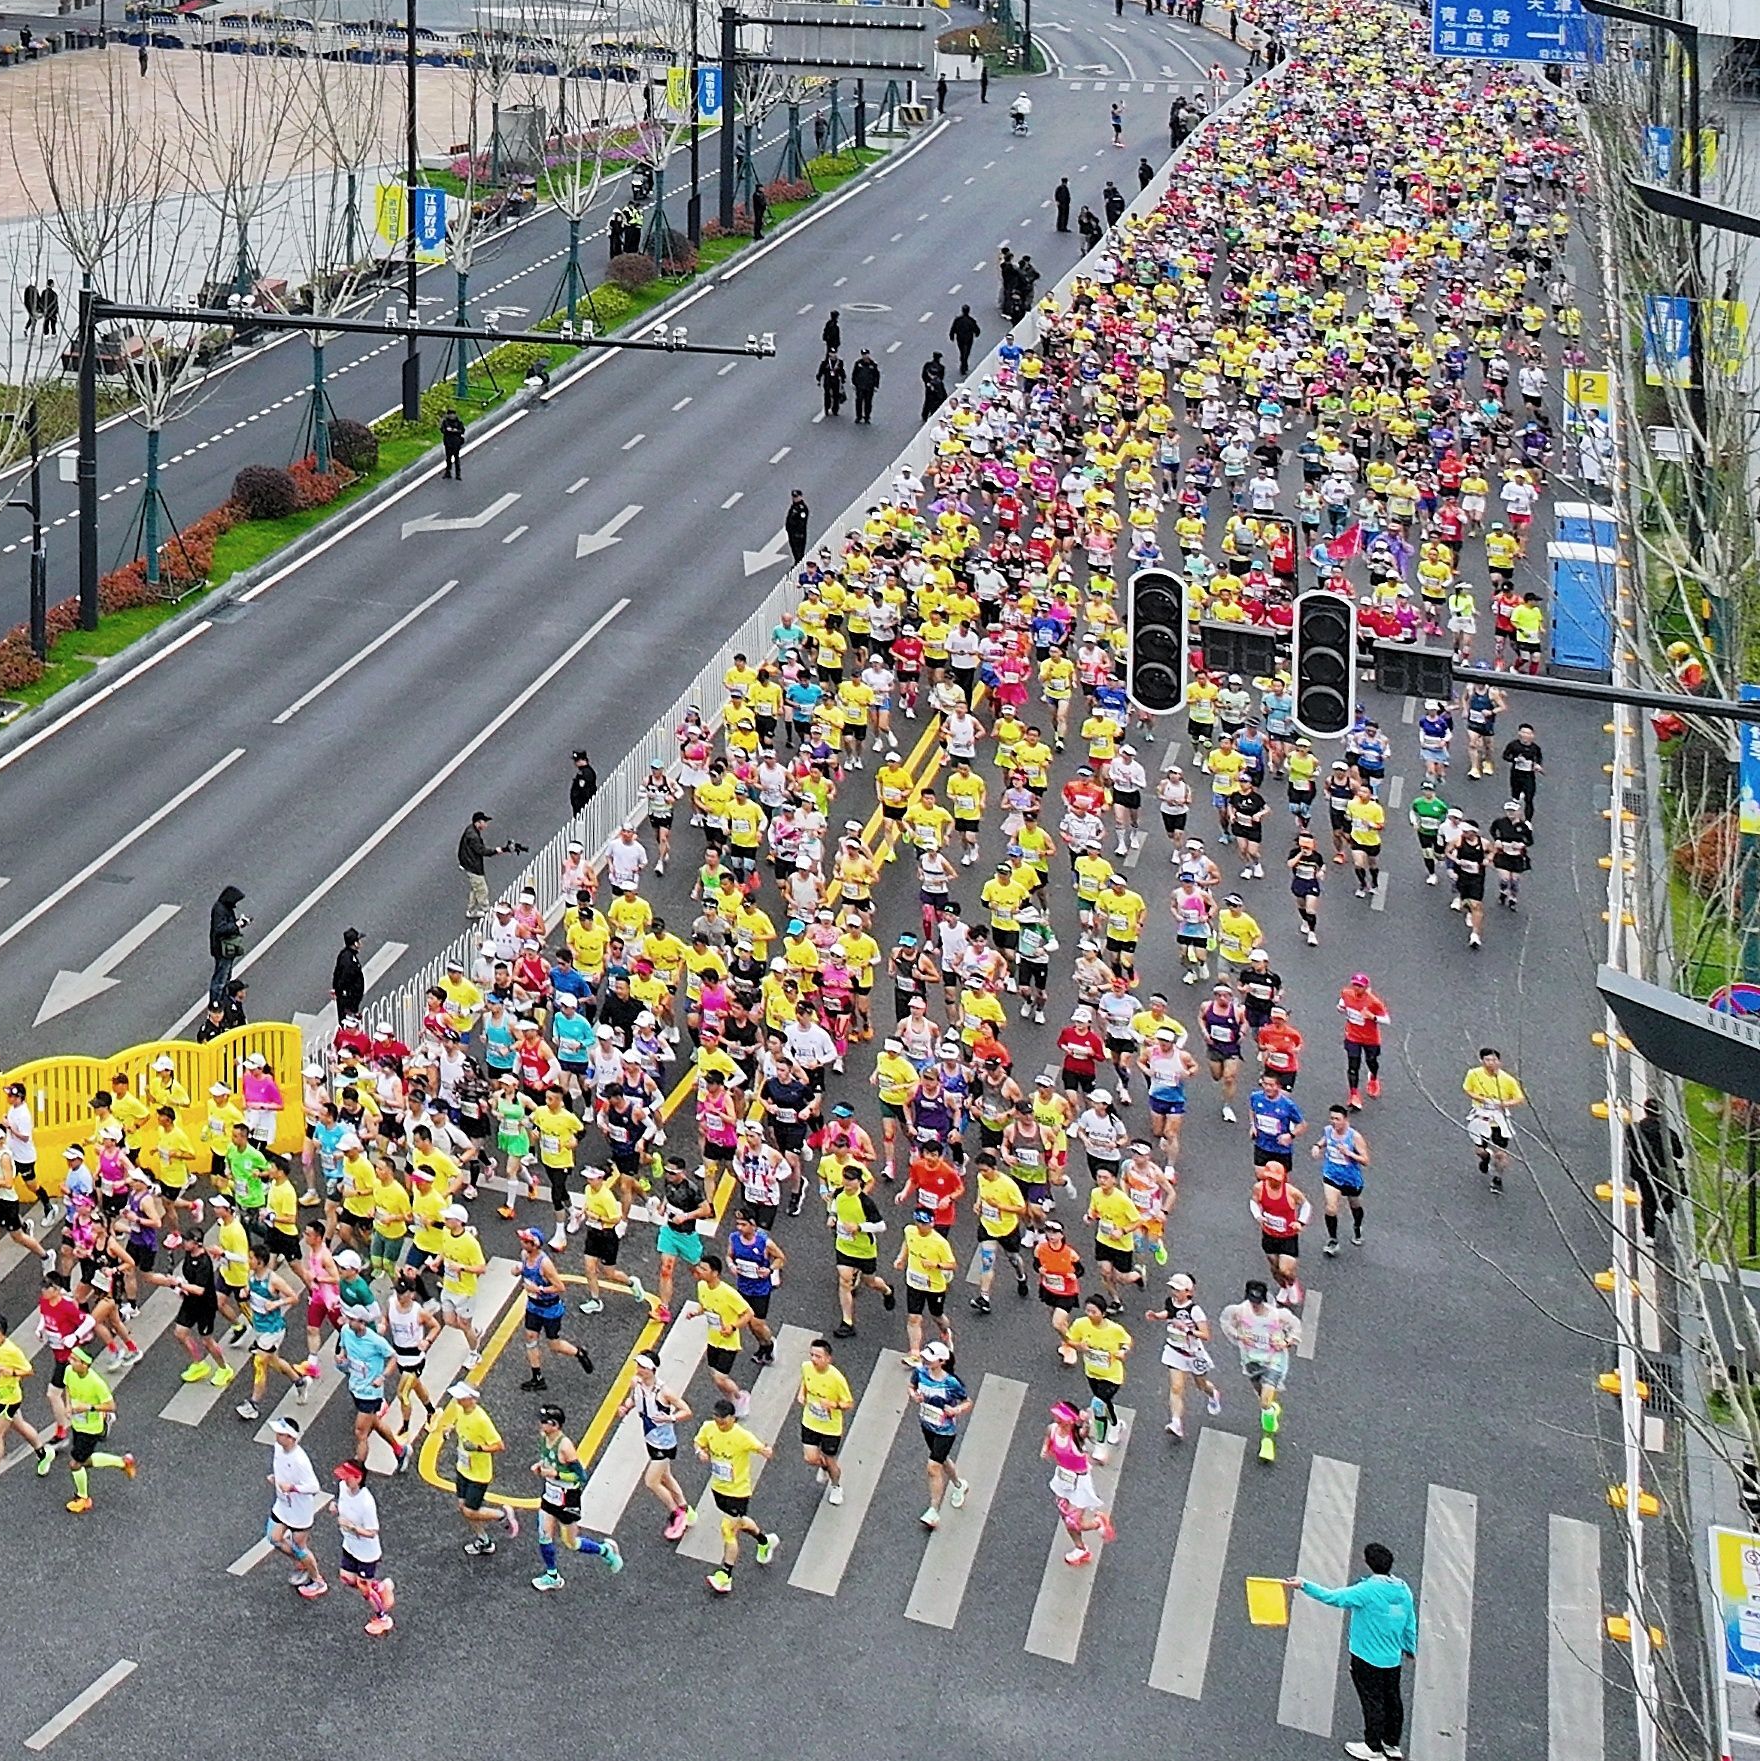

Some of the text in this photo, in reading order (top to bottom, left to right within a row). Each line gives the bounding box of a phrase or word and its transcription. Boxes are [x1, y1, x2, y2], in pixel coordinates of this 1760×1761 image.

[1440, 7, 1511, 25] 青岛路
[1439, 30, 1510, 48] 洞庭街
[1582, 378, 1596, 393] 2
